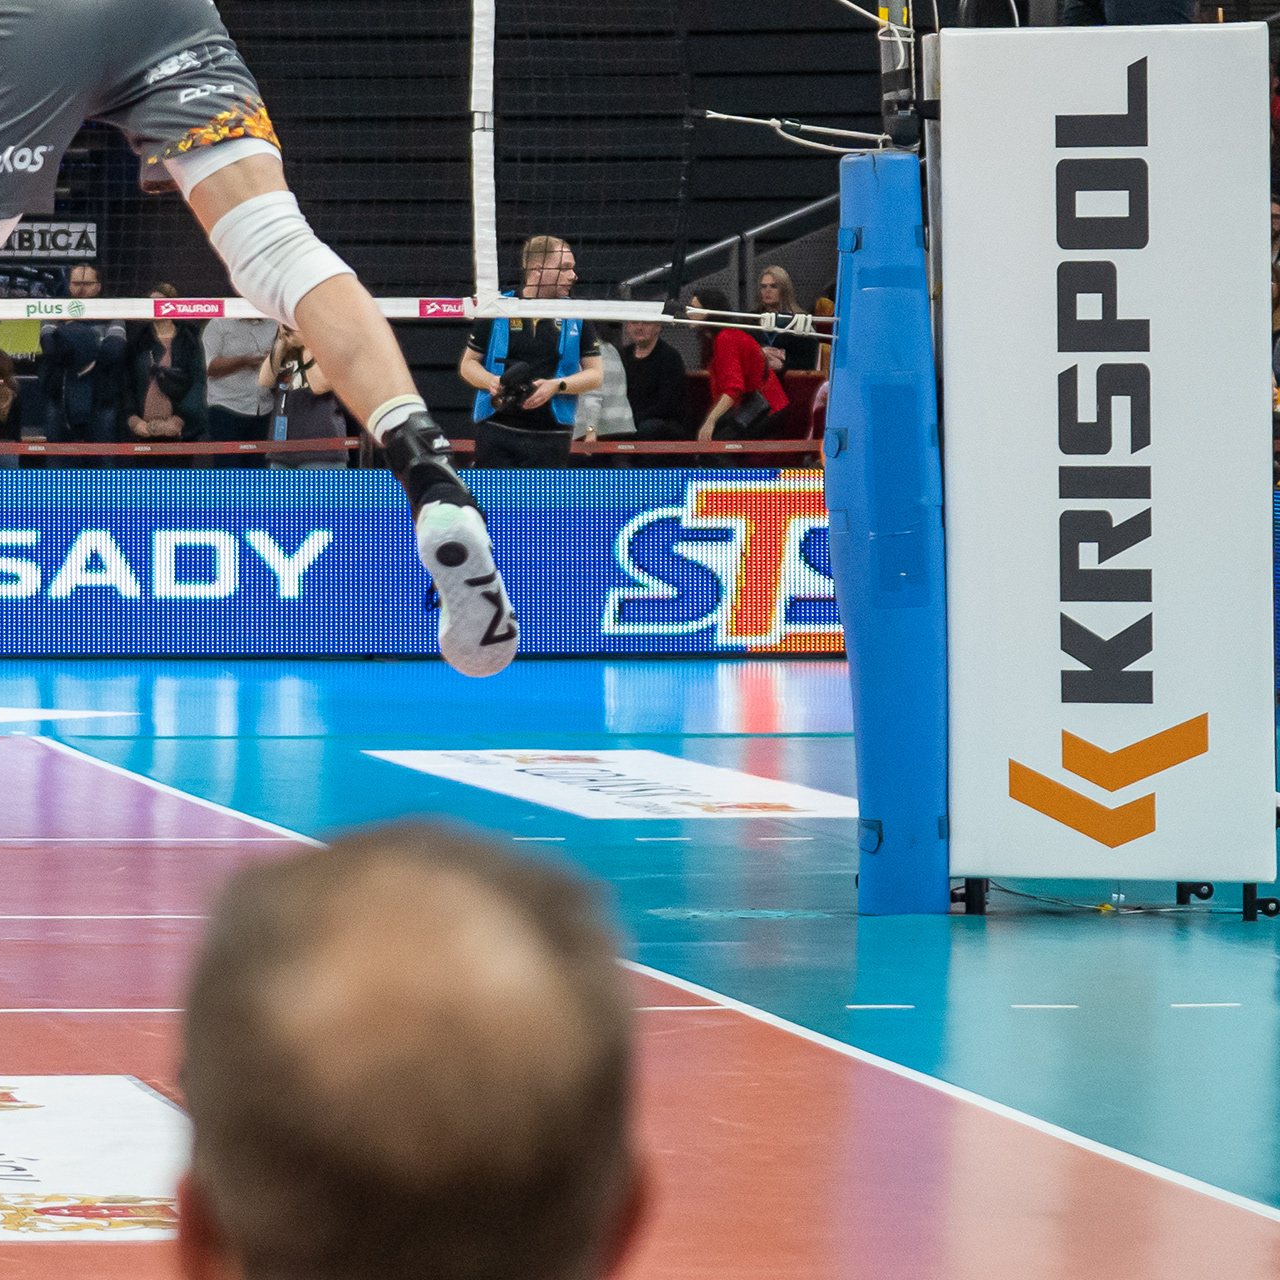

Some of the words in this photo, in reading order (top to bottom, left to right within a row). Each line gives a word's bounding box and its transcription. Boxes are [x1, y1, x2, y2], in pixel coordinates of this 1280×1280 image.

[27, 302, 63, 319] plus
[176, 304, 220, 314] TAURON
[1054, 55, 1155, 705] KRISPOL
